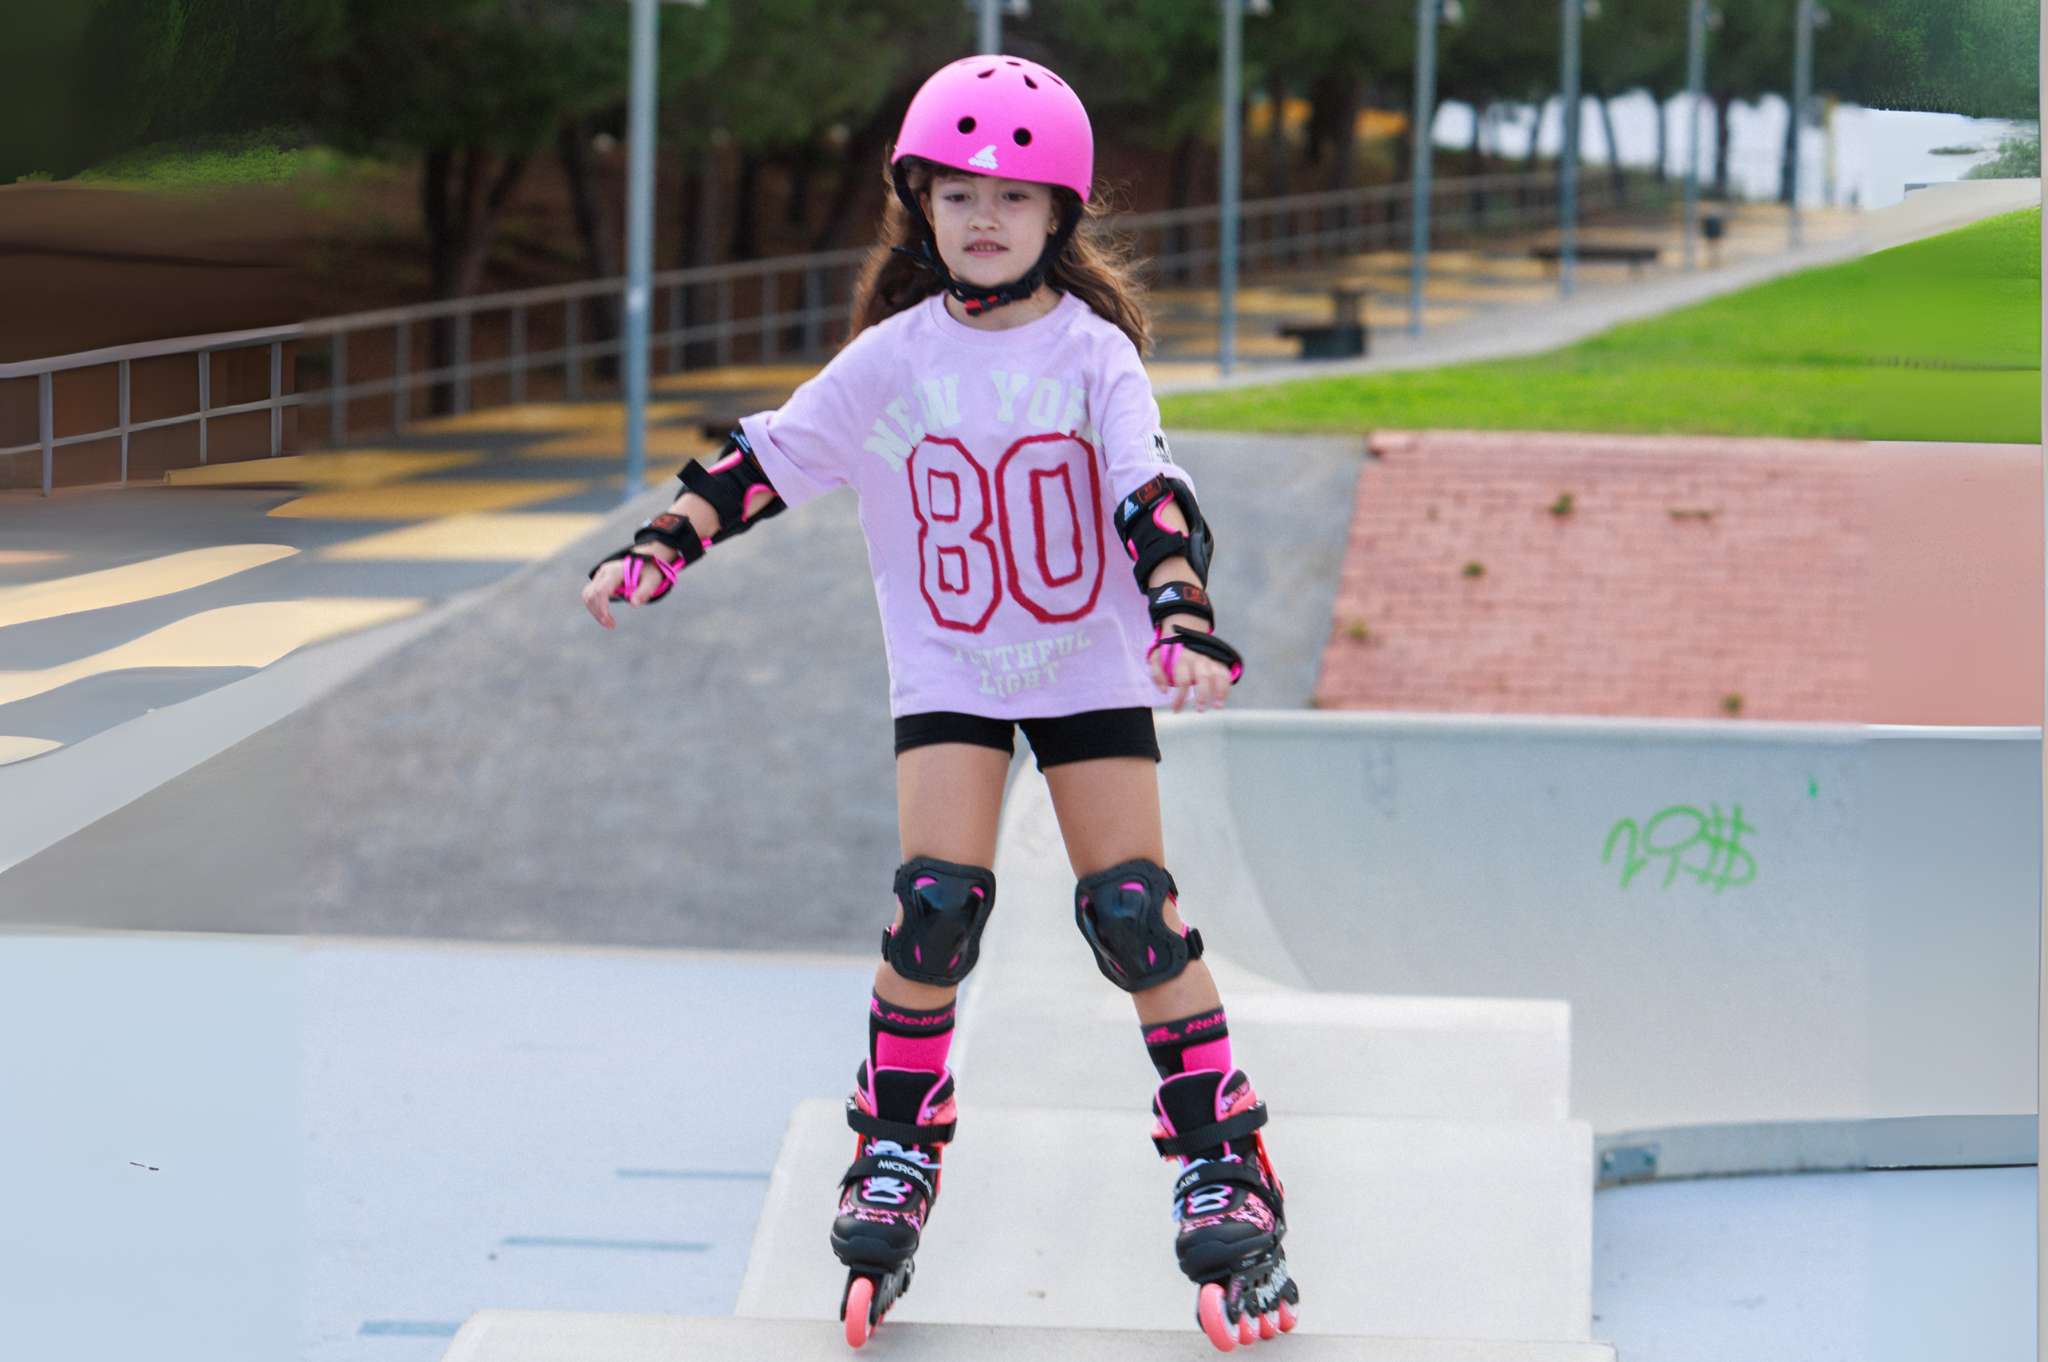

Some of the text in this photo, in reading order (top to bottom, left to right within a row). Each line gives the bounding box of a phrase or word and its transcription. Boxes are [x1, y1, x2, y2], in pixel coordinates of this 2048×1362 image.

[863, 369, 1104, 473] NEW YOR
[906, 432, 1105, 635] 80
